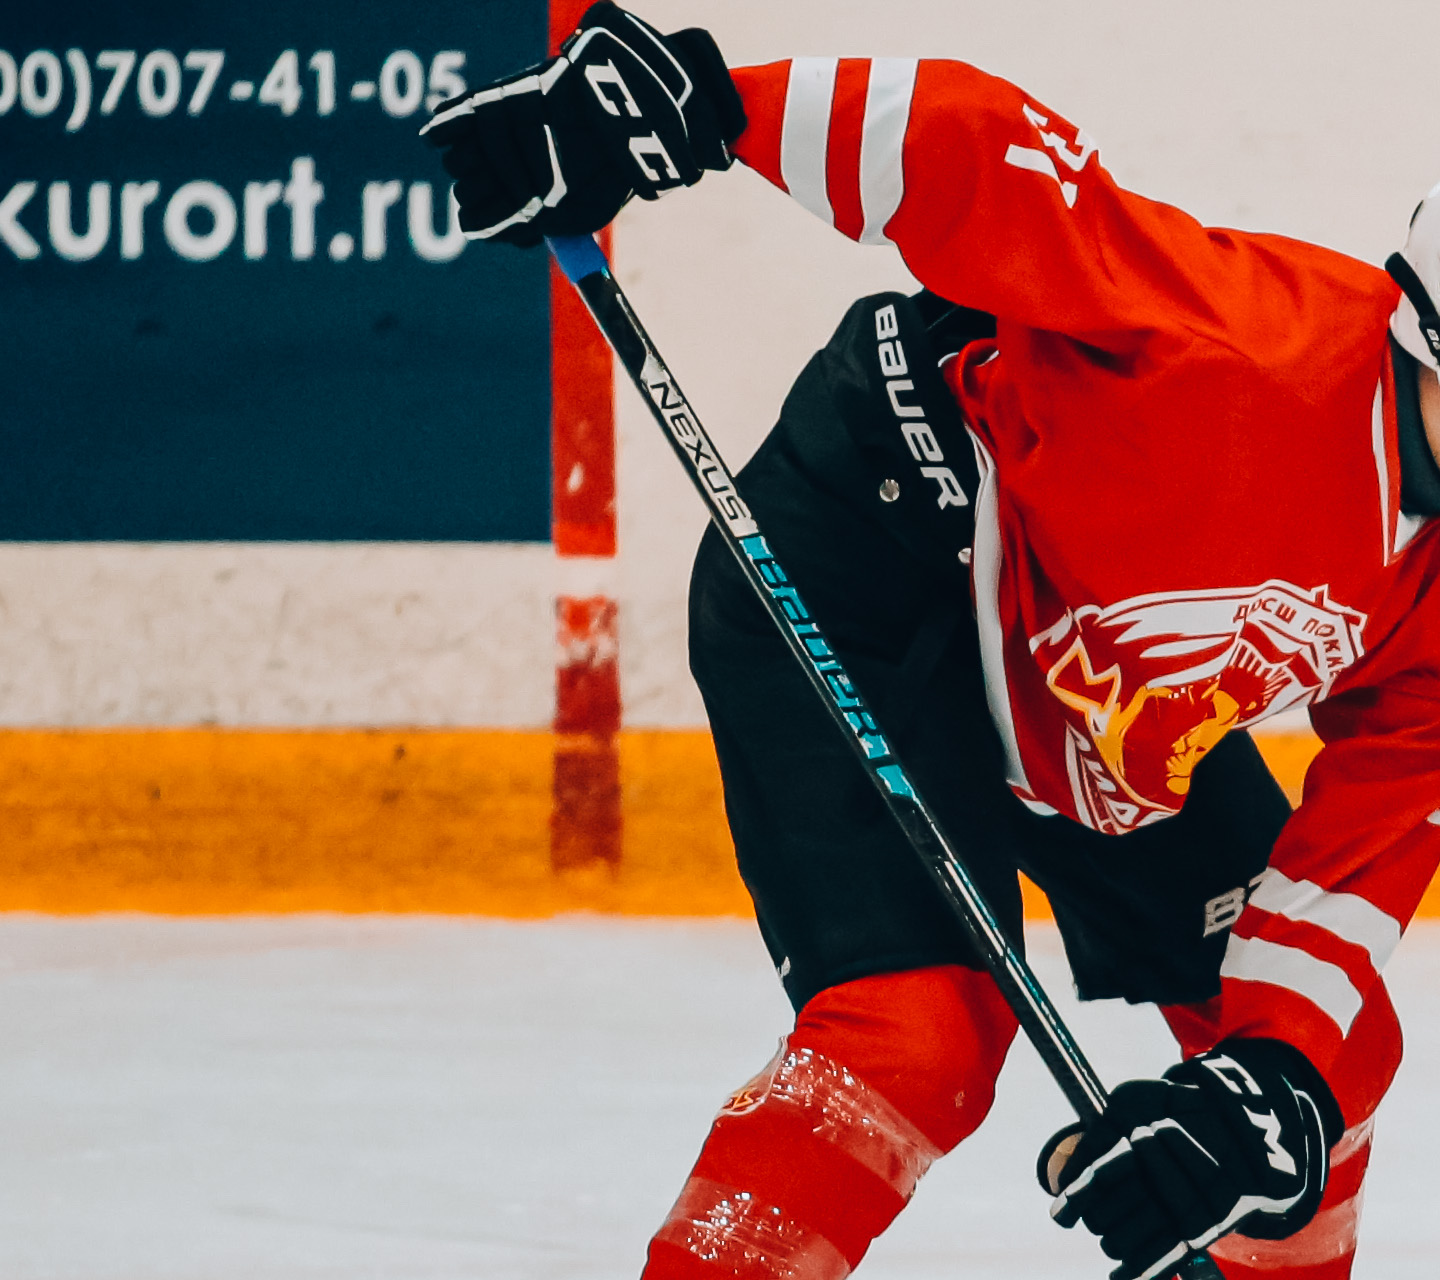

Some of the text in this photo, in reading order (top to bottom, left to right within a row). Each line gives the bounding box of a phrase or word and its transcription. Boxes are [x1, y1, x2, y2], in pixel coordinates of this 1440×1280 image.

[583, 58, 682, 201] CC
[650, 378, 751, 523] NEXUS
[875, 303, 970, 511] BAUER
